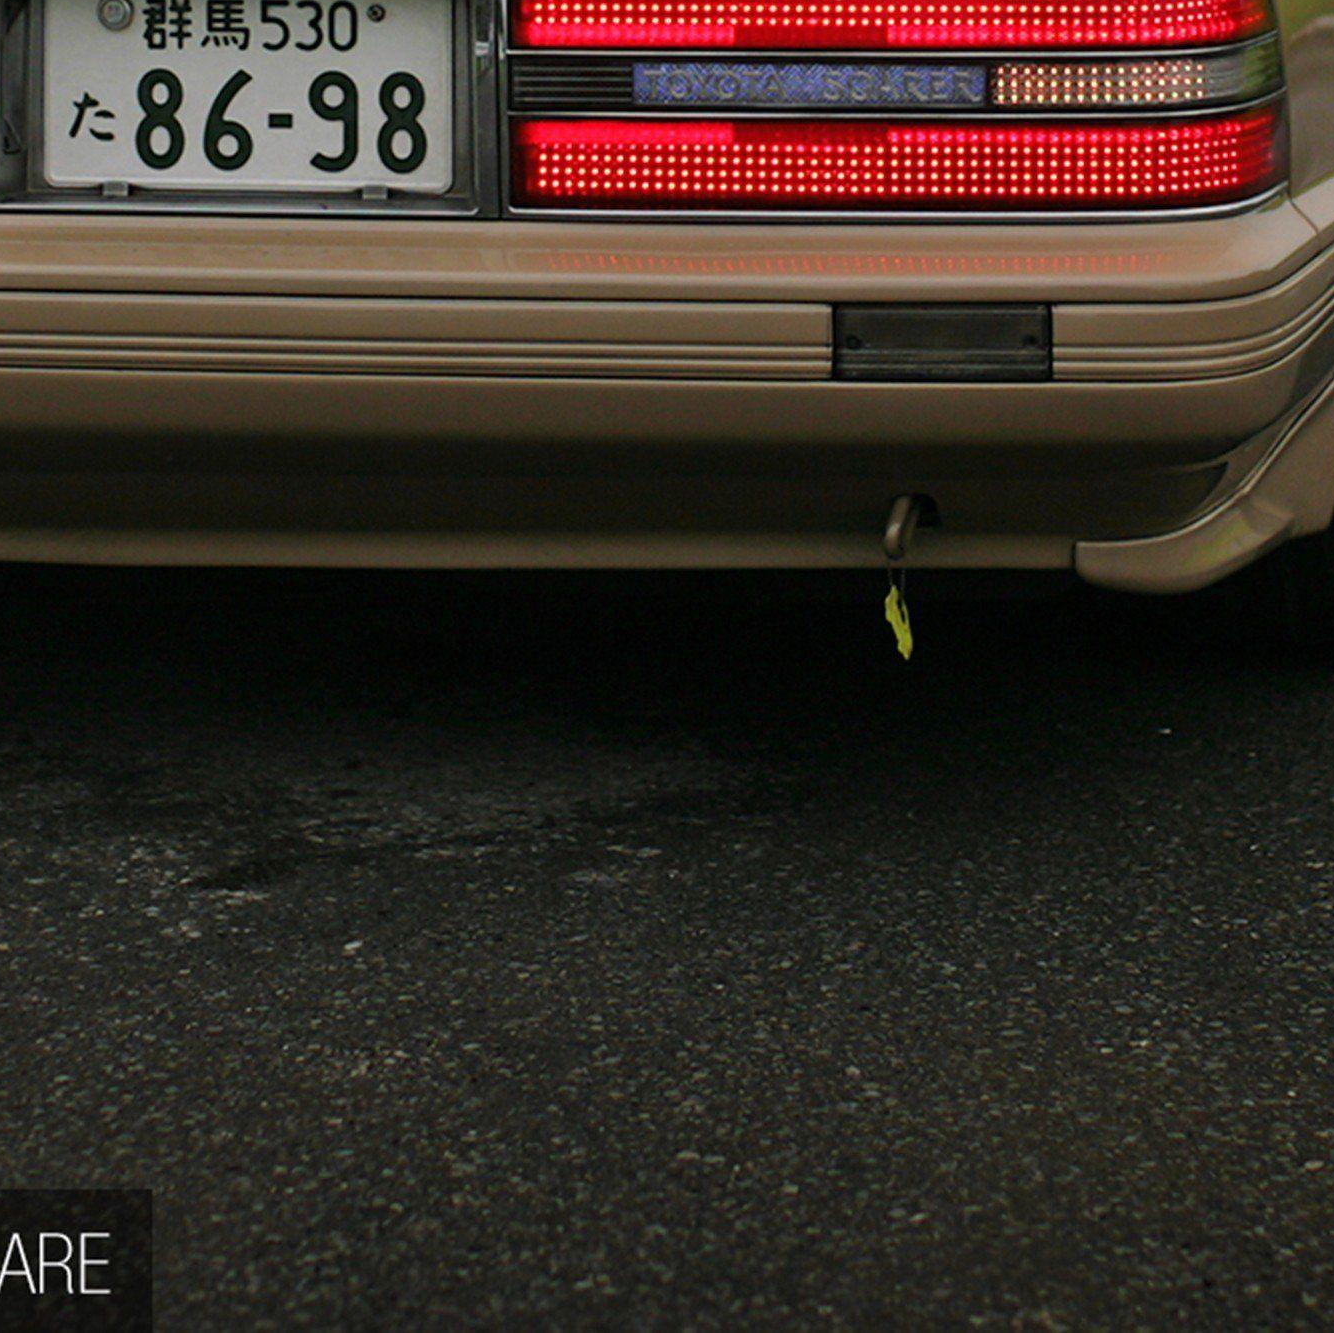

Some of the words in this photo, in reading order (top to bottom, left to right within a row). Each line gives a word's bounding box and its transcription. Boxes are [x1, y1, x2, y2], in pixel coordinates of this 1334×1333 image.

[643, 69, 787, 100] TOYOTA
[823, 69, 983, 102] SOARER
[69, 92, 115, 142] た
[134, 68, 428, 174] 86-98
